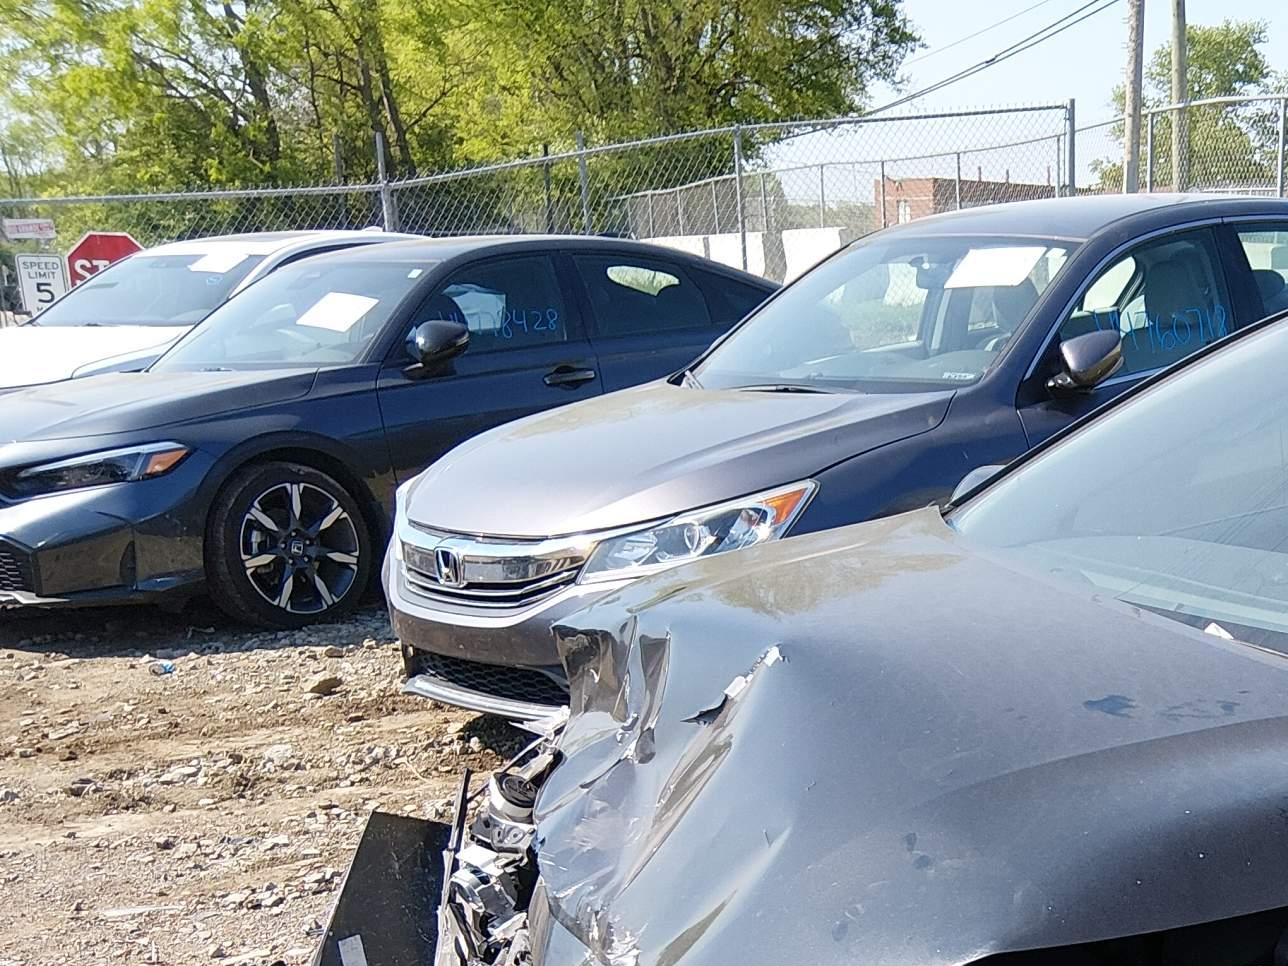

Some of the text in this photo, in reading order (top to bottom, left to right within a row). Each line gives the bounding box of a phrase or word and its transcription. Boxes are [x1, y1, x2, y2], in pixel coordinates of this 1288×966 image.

[22, 261, 59, 270] SPEED
[28, 271, 56, 279] LIMIT
[74, 259, 110, 288] ST
[36, 282, 55, 303] 5
